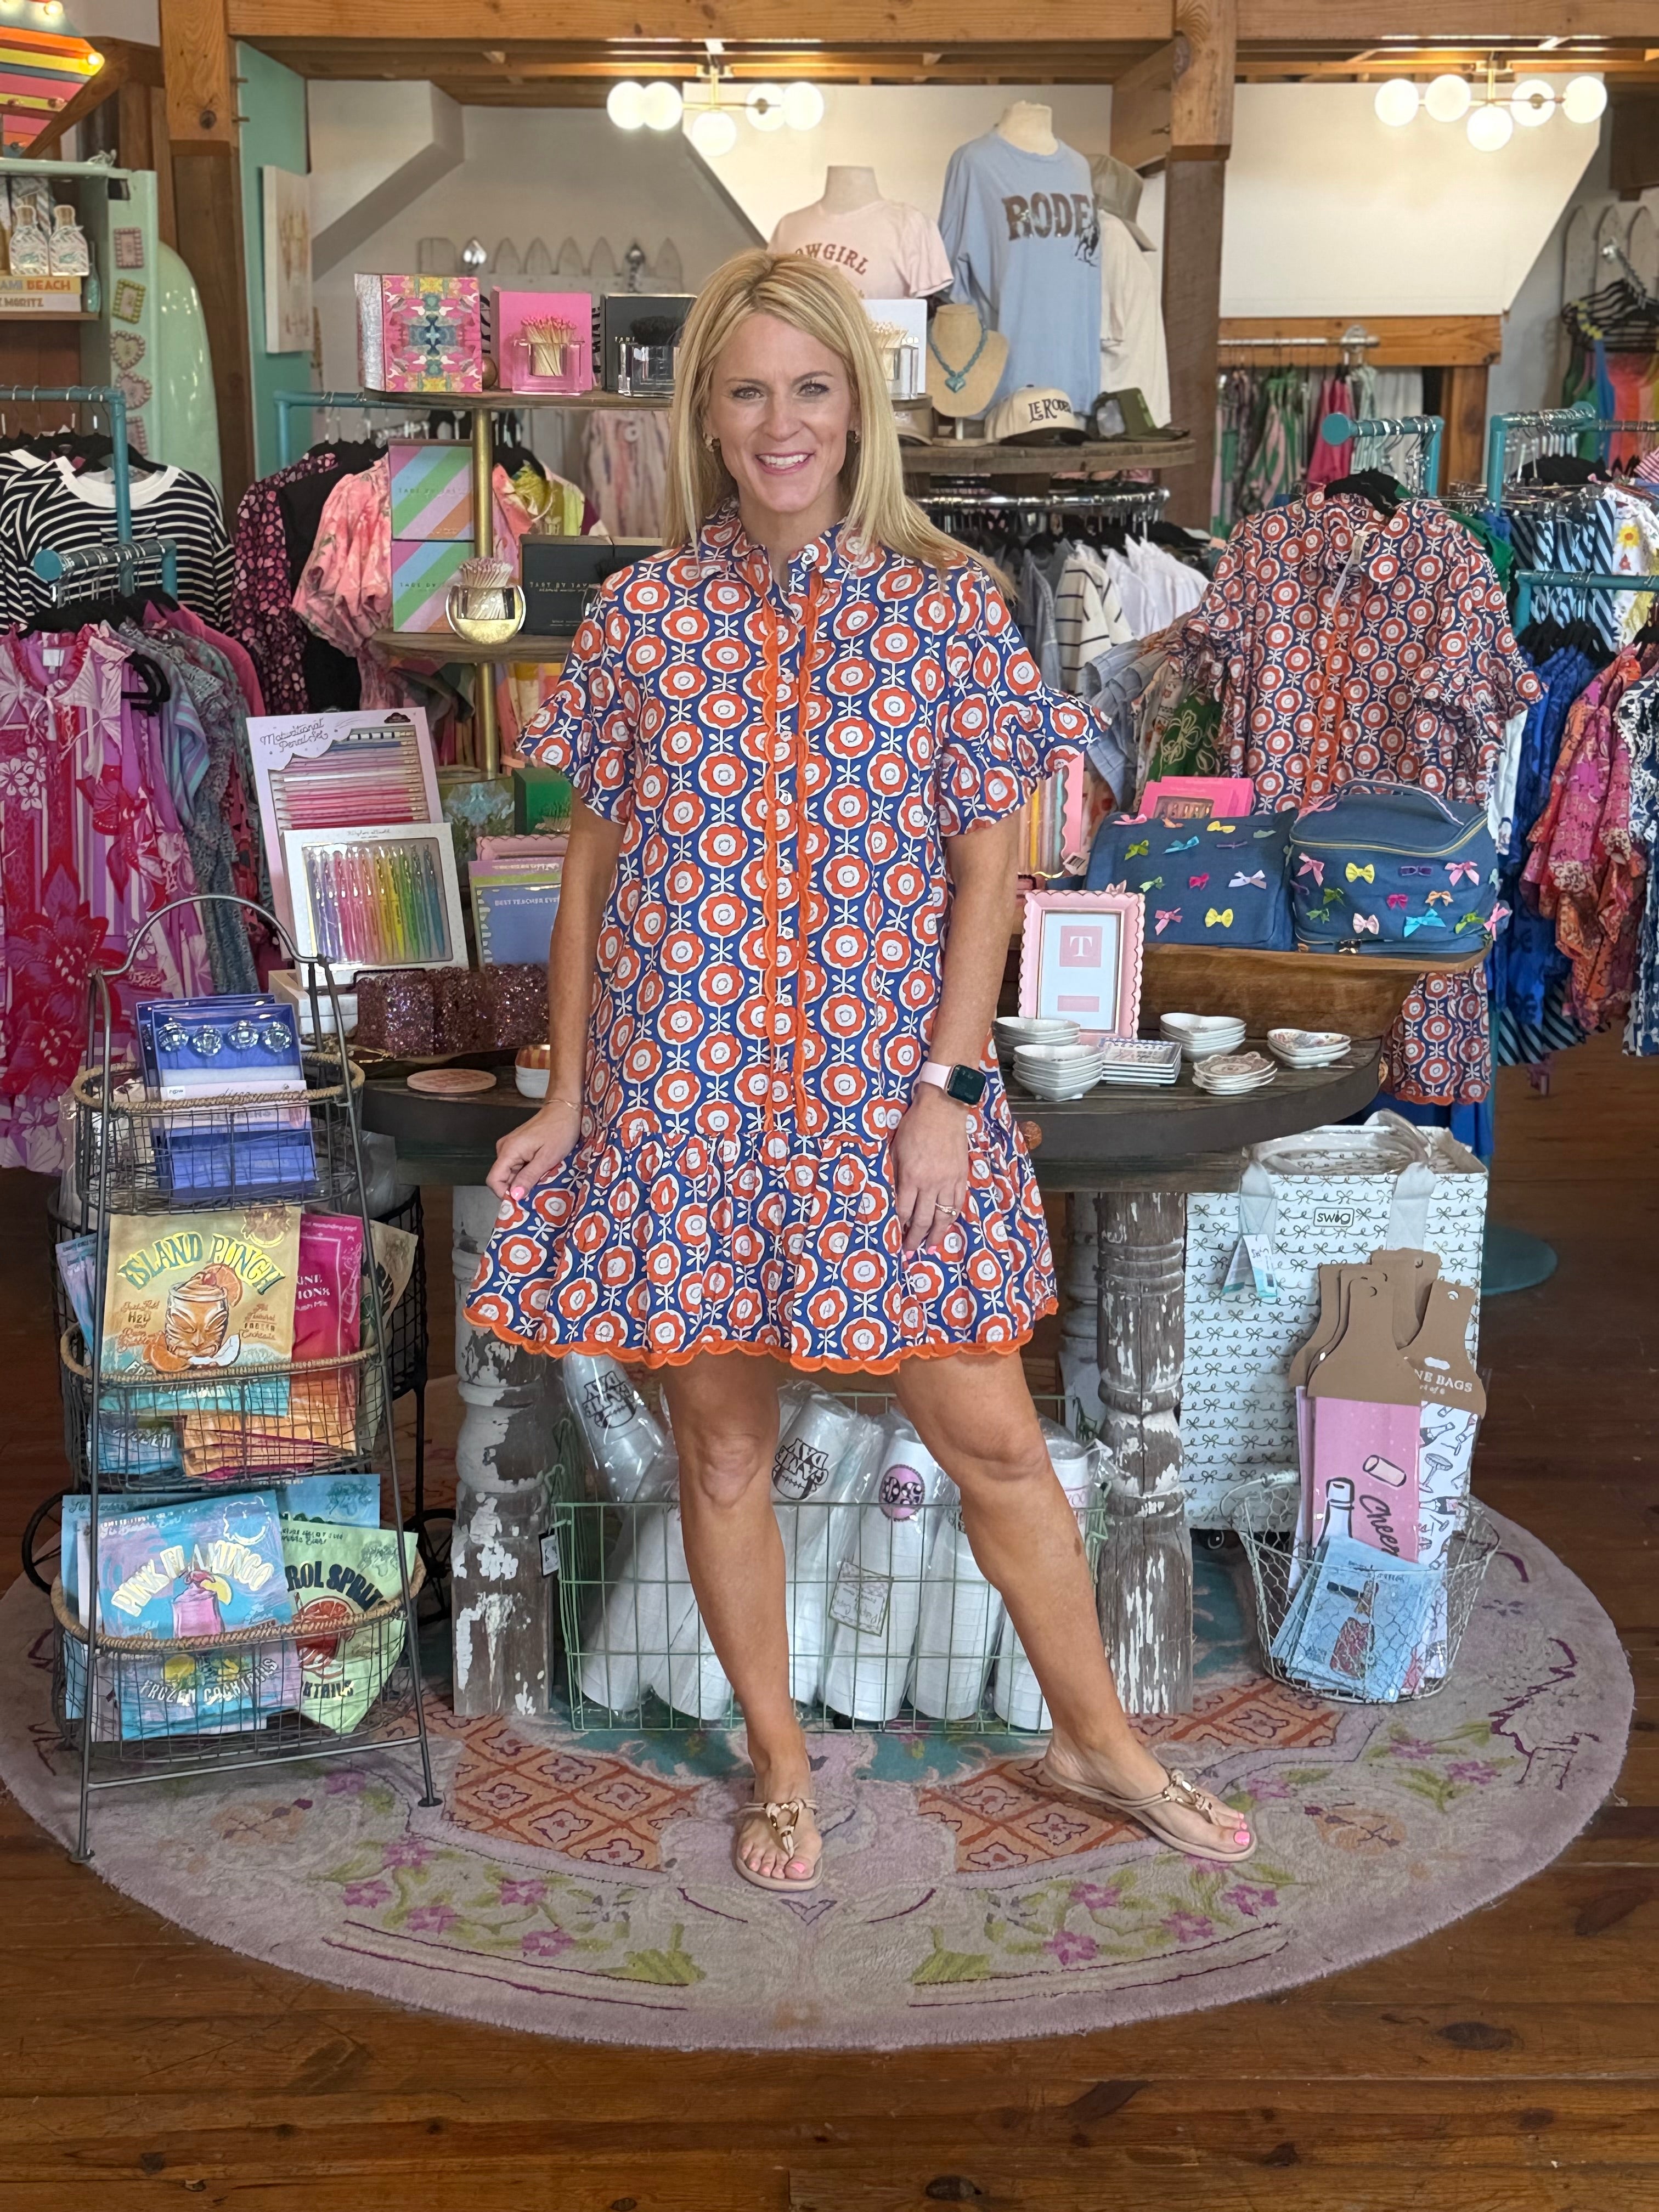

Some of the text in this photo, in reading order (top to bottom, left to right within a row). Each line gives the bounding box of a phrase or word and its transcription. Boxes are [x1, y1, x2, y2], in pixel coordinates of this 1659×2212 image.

[795, 242, 868, 276] WGIRL
[0, 280, 71, 290] AMI BEACH
[1028, 401, 1043, 424] LE
[1070, 936, 1092, 957] T
[117, 1231, 286, 1296] ISLAND PUNCH
[1436, 1374, 1472, 1392] BAGS
[1359, 1494, 1400, 1557] Cheer
[285, 1561, 388, 1612] ROL SPRIT
[303, 1680, 354, 1699] KTAILS
